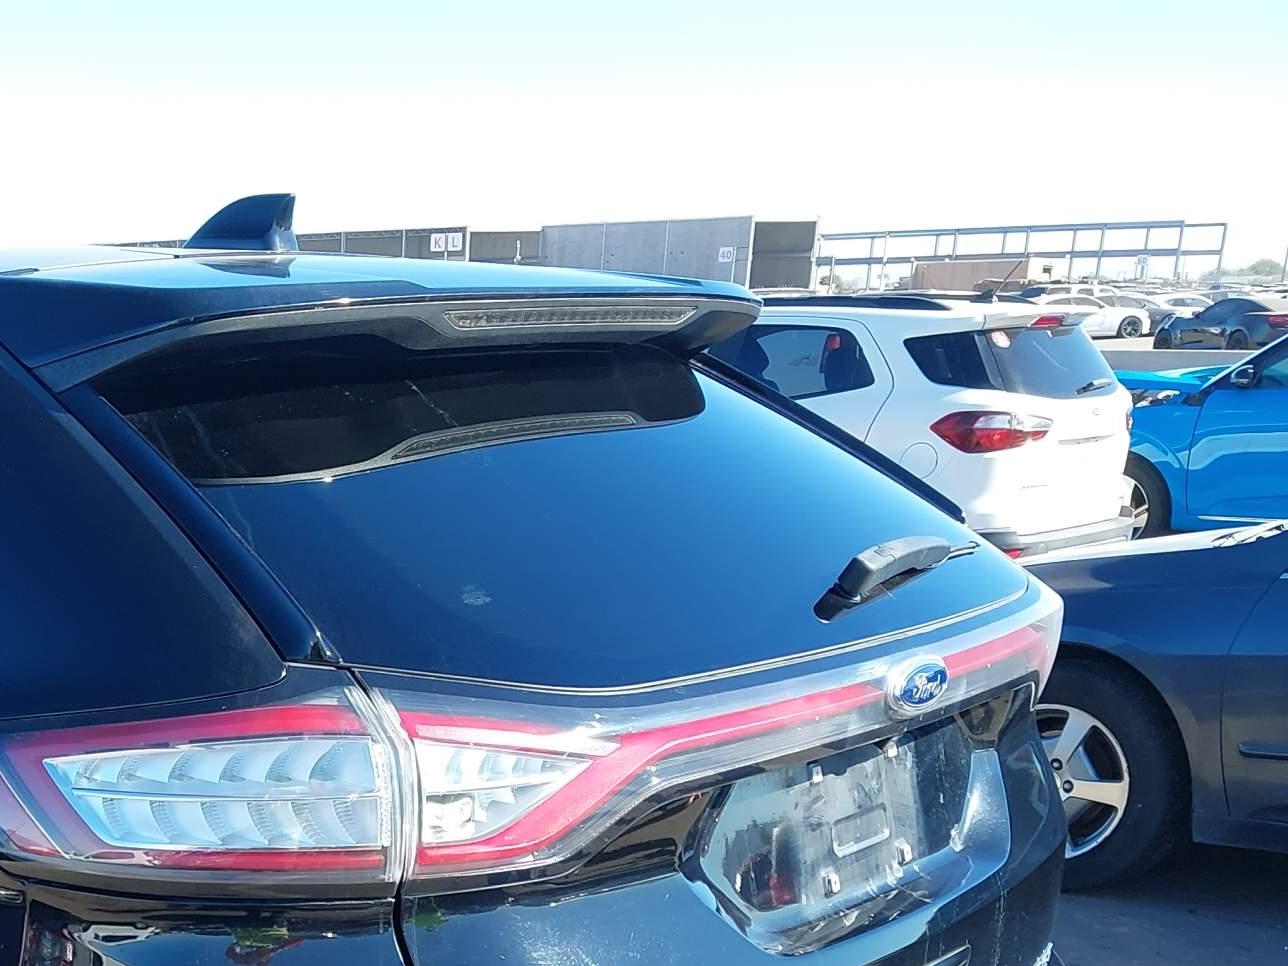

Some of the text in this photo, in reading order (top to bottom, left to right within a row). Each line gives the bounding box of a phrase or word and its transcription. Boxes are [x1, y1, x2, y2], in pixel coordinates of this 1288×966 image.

[434, 237, 442, 249] K
[720, 250, 732, 260] 40
[911, 670, 945, 700] Ford
